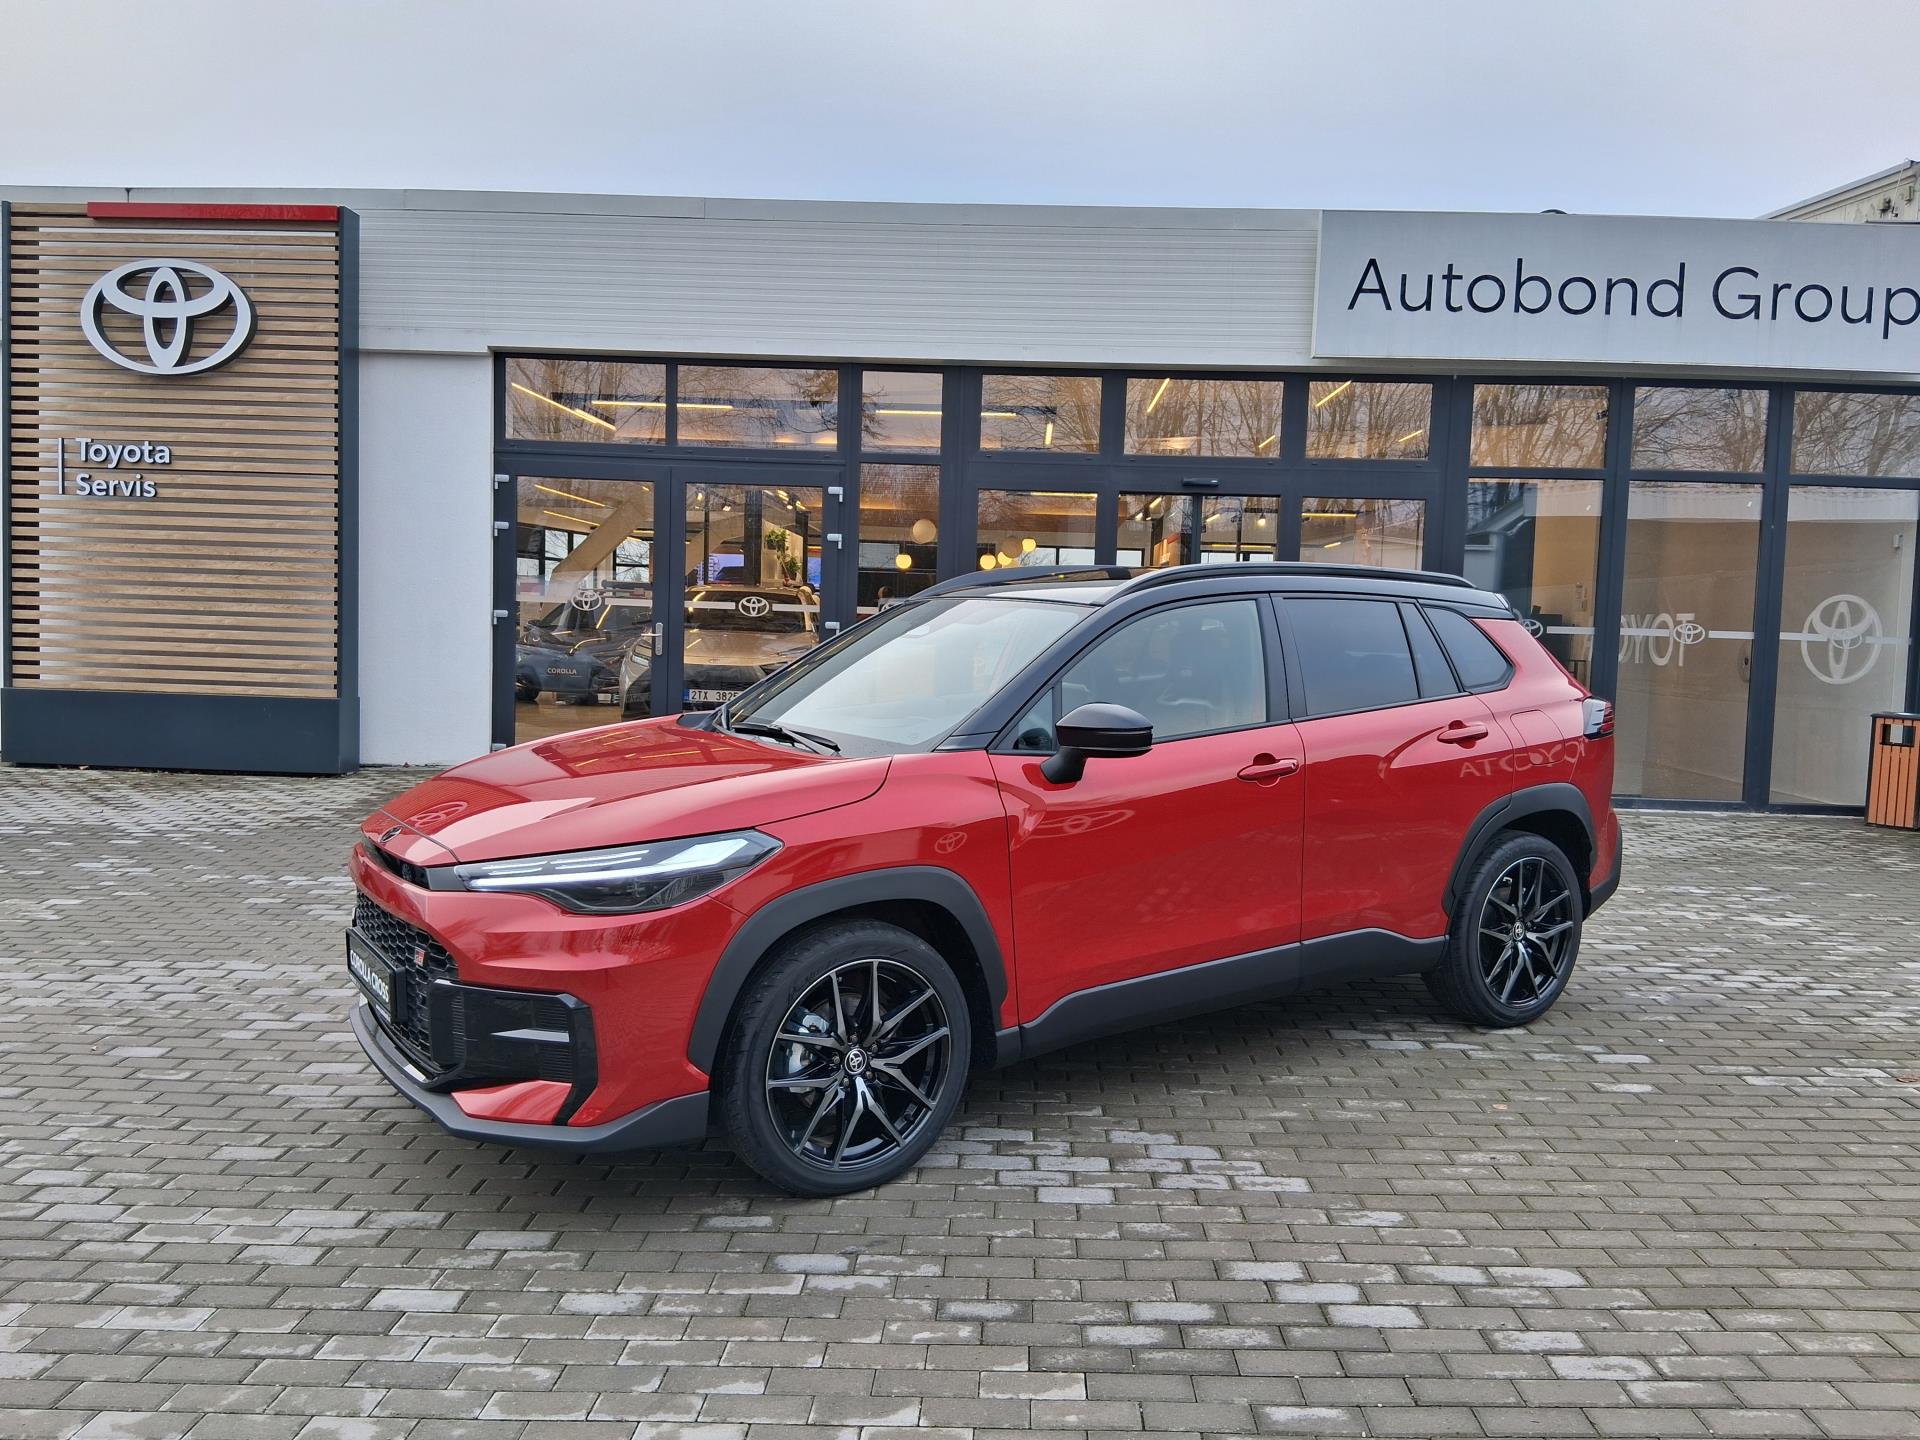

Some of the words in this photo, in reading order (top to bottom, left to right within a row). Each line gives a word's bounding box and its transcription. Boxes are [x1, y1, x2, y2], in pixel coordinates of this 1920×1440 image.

[1347, 257, 1687, 319] Autobond
[1711, 266, 1920, 340] Group
[75, 437, 171, 469] Toyota
[76, 473, 156, 498] Servis
[547, 667, 577, 675] COROLLA
[691, 690, 709, 700] 2TX
[350, 949, 372, 986] COROLLA
[371, 971, 389, 1003] CROSS
